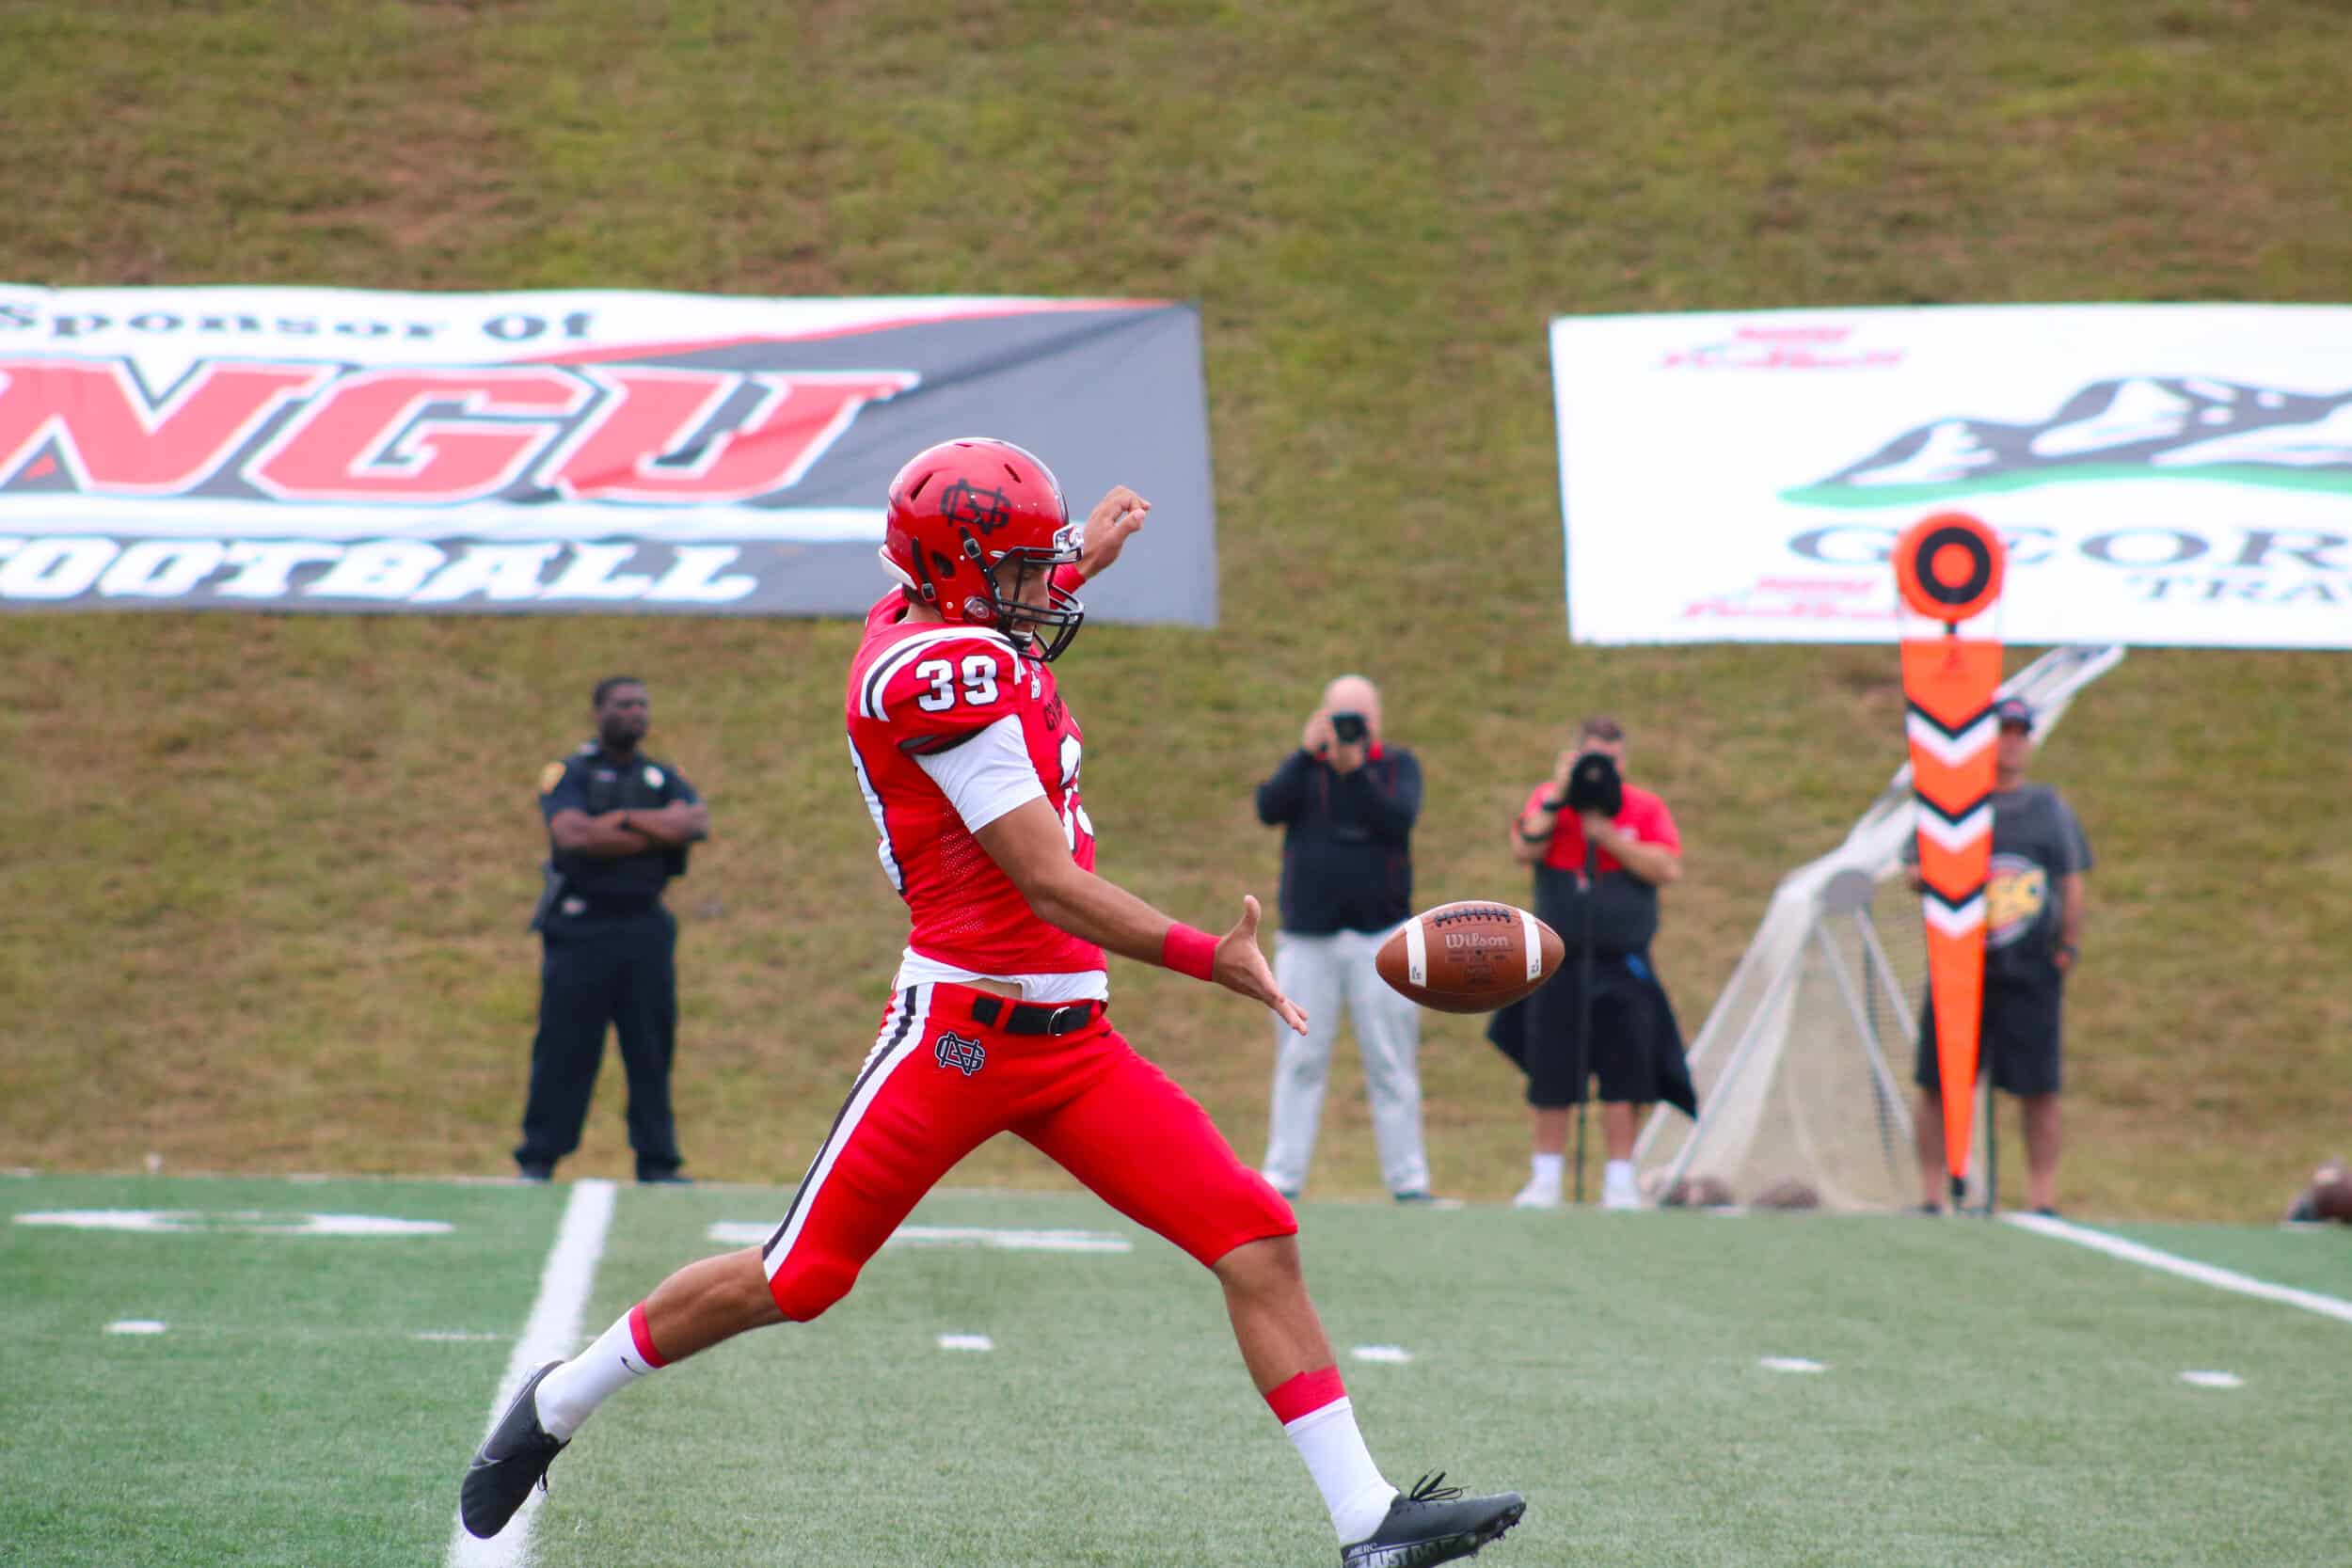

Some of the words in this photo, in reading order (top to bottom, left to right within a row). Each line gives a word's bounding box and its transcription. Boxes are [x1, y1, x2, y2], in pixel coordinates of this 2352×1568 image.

[0, 358, 921, 504] NGU
[0, 537, 756, 602] OOTBALL
[914, 654, 999, 712] 39
[1445, 932, 1508, 950] Wilson
